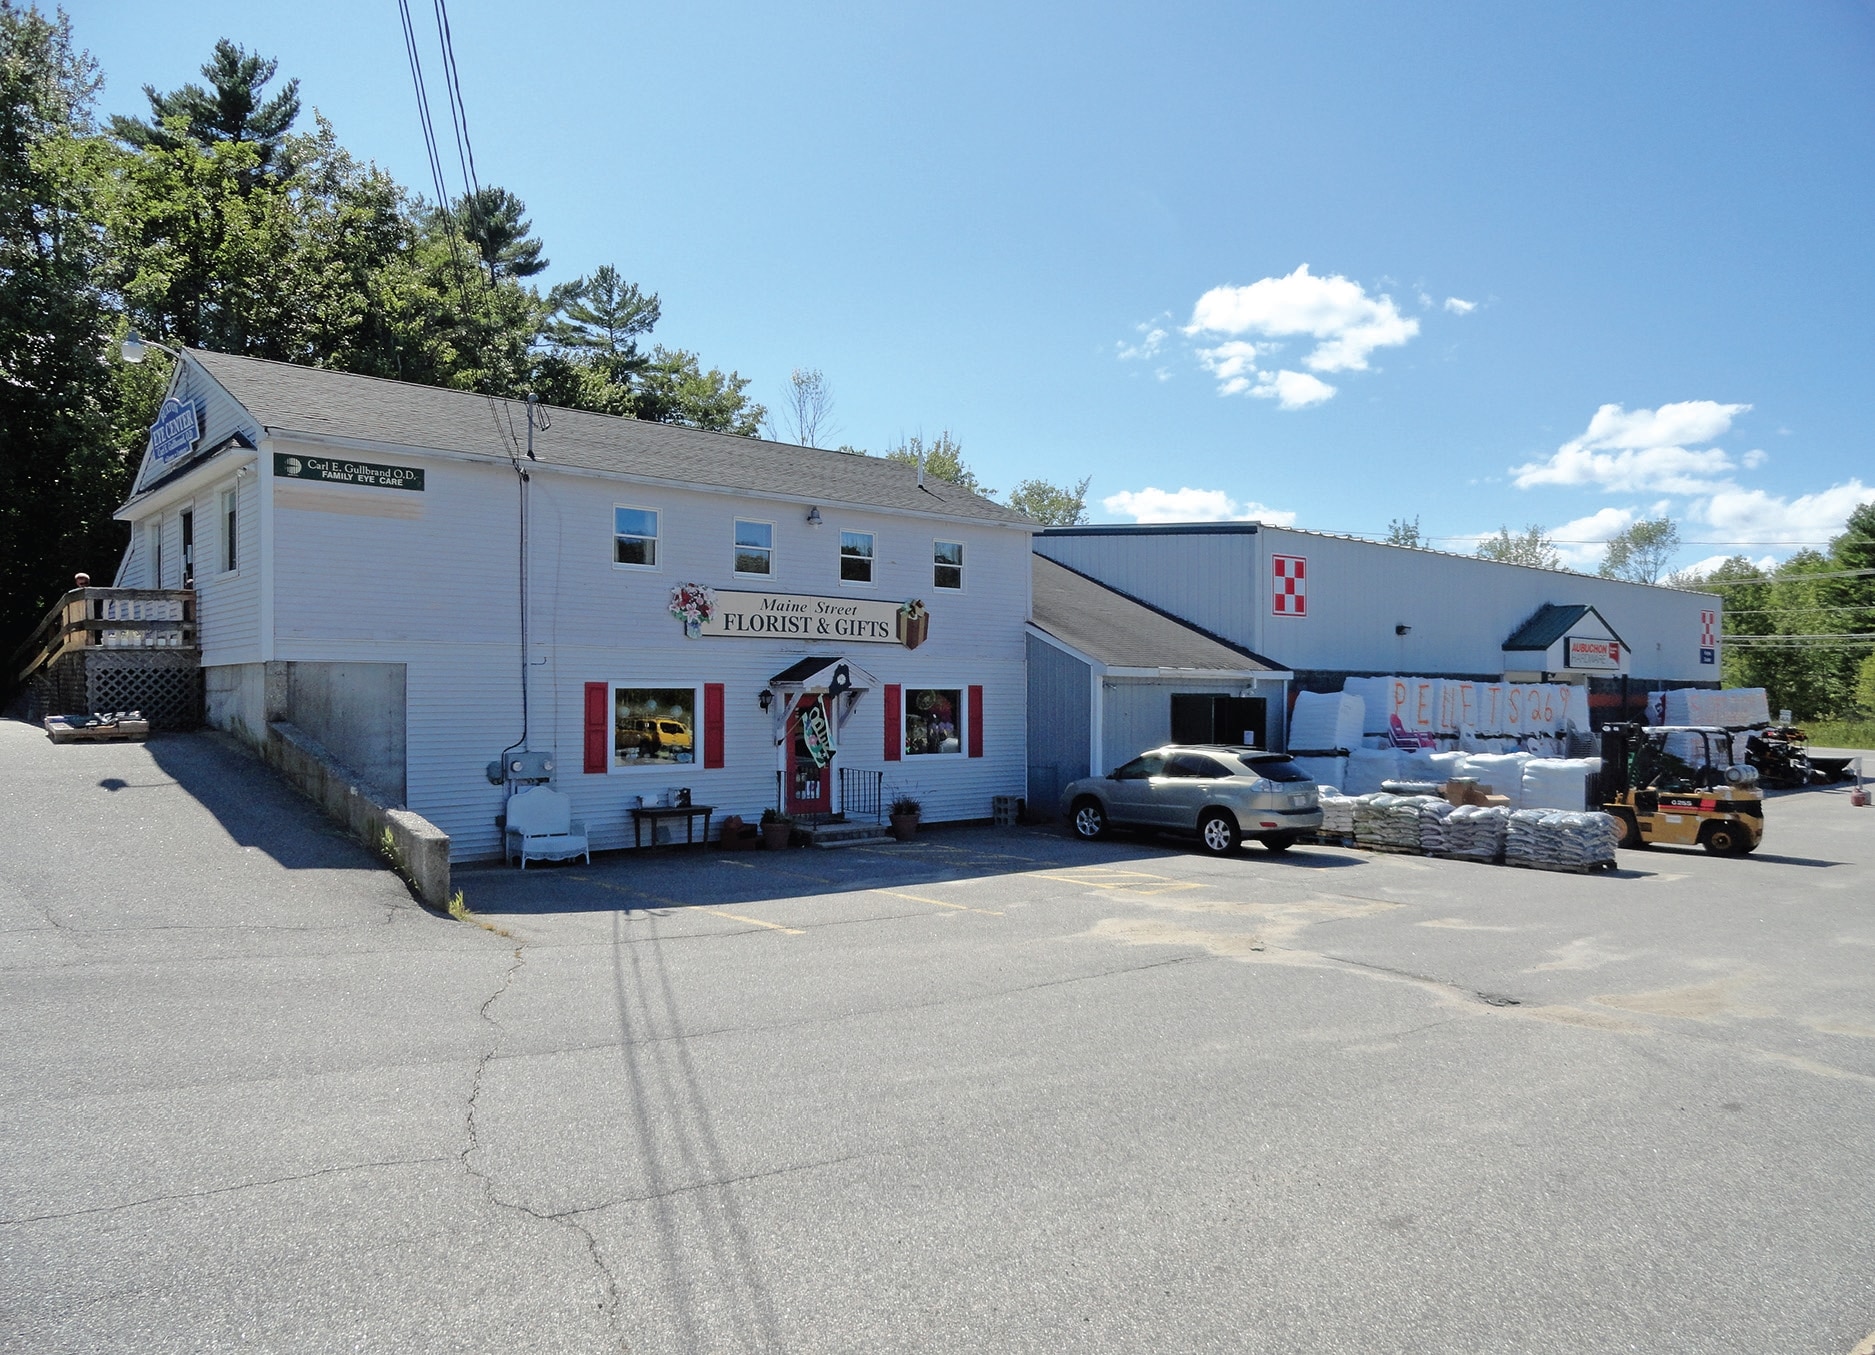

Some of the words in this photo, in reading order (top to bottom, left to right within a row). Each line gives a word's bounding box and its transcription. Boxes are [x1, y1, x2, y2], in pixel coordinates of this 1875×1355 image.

[153, 426, 166, 447] EYE
[165, 409, 194, 438] CENTER
[307, 459, 329, 471] Carl
[332, 462, 342, 472] E.
[344, 463, 391, 478] Gullbrand
[393, 469, 417, 481] O.D.
[321, 470, 354, 481] FAMILY
[357, 474, 375, 484] EYE
[379, 476, 403, 486] CARE
[760, 598, 808, 613] Maine
[815, 601, 858, 616] Street
[723, 613, 812, 634] FLORIST
[816, 617, 831, 635] &
[835, 618, 889, 638] GIFTS
[1572, 642, 1608, 654] AUBUCHON
[1394, 682, 1522, 728] PELLETS
